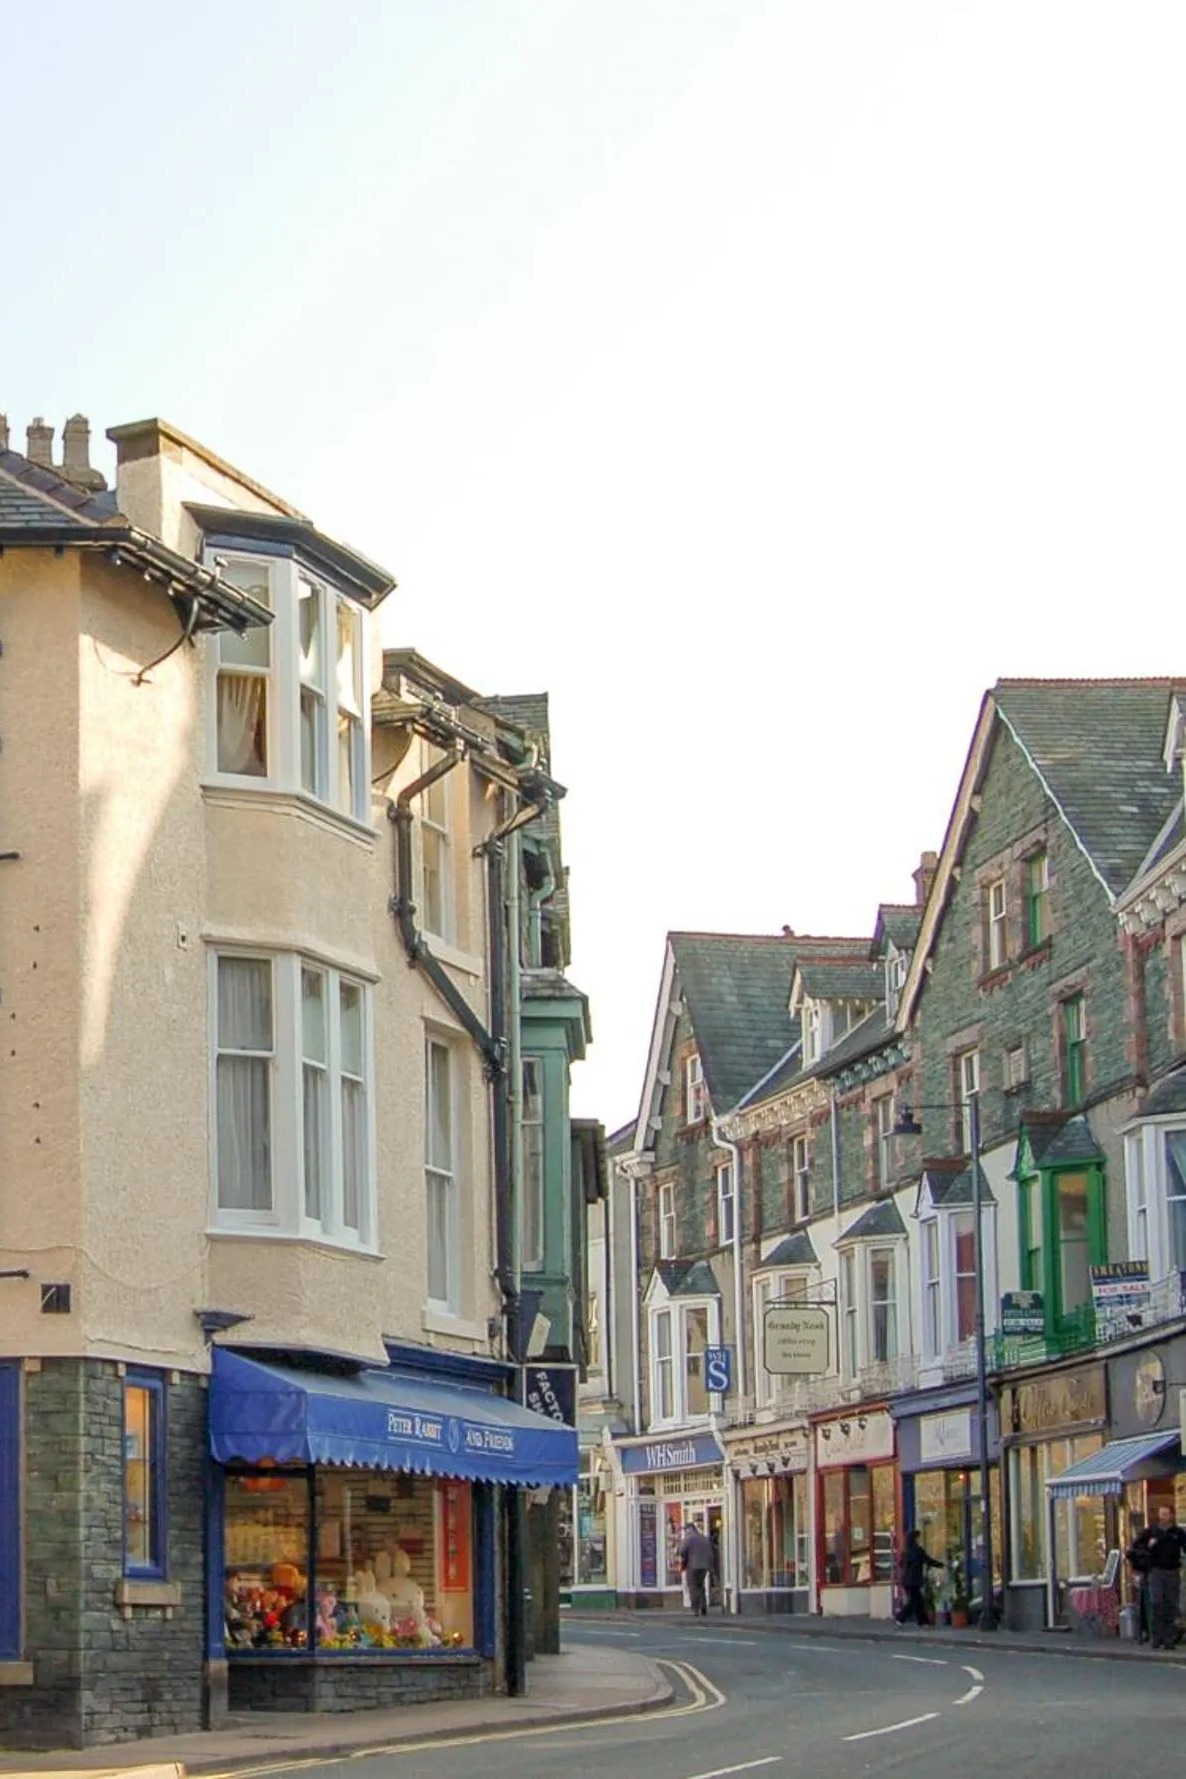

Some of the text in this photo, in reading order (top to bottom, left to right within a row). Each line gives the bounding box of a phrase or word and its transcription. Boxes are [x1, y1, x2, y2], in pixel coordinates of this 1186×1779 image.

[708, 1360, 728, 1391] S
[535, 1371, 564, 1421] FACTO
[387, 1412, 443, 1440] PETER RABBIT
[465, 1428, 514, 1450] AND FRIENDS
[646, 1440, 697, 1469] WHSmith
